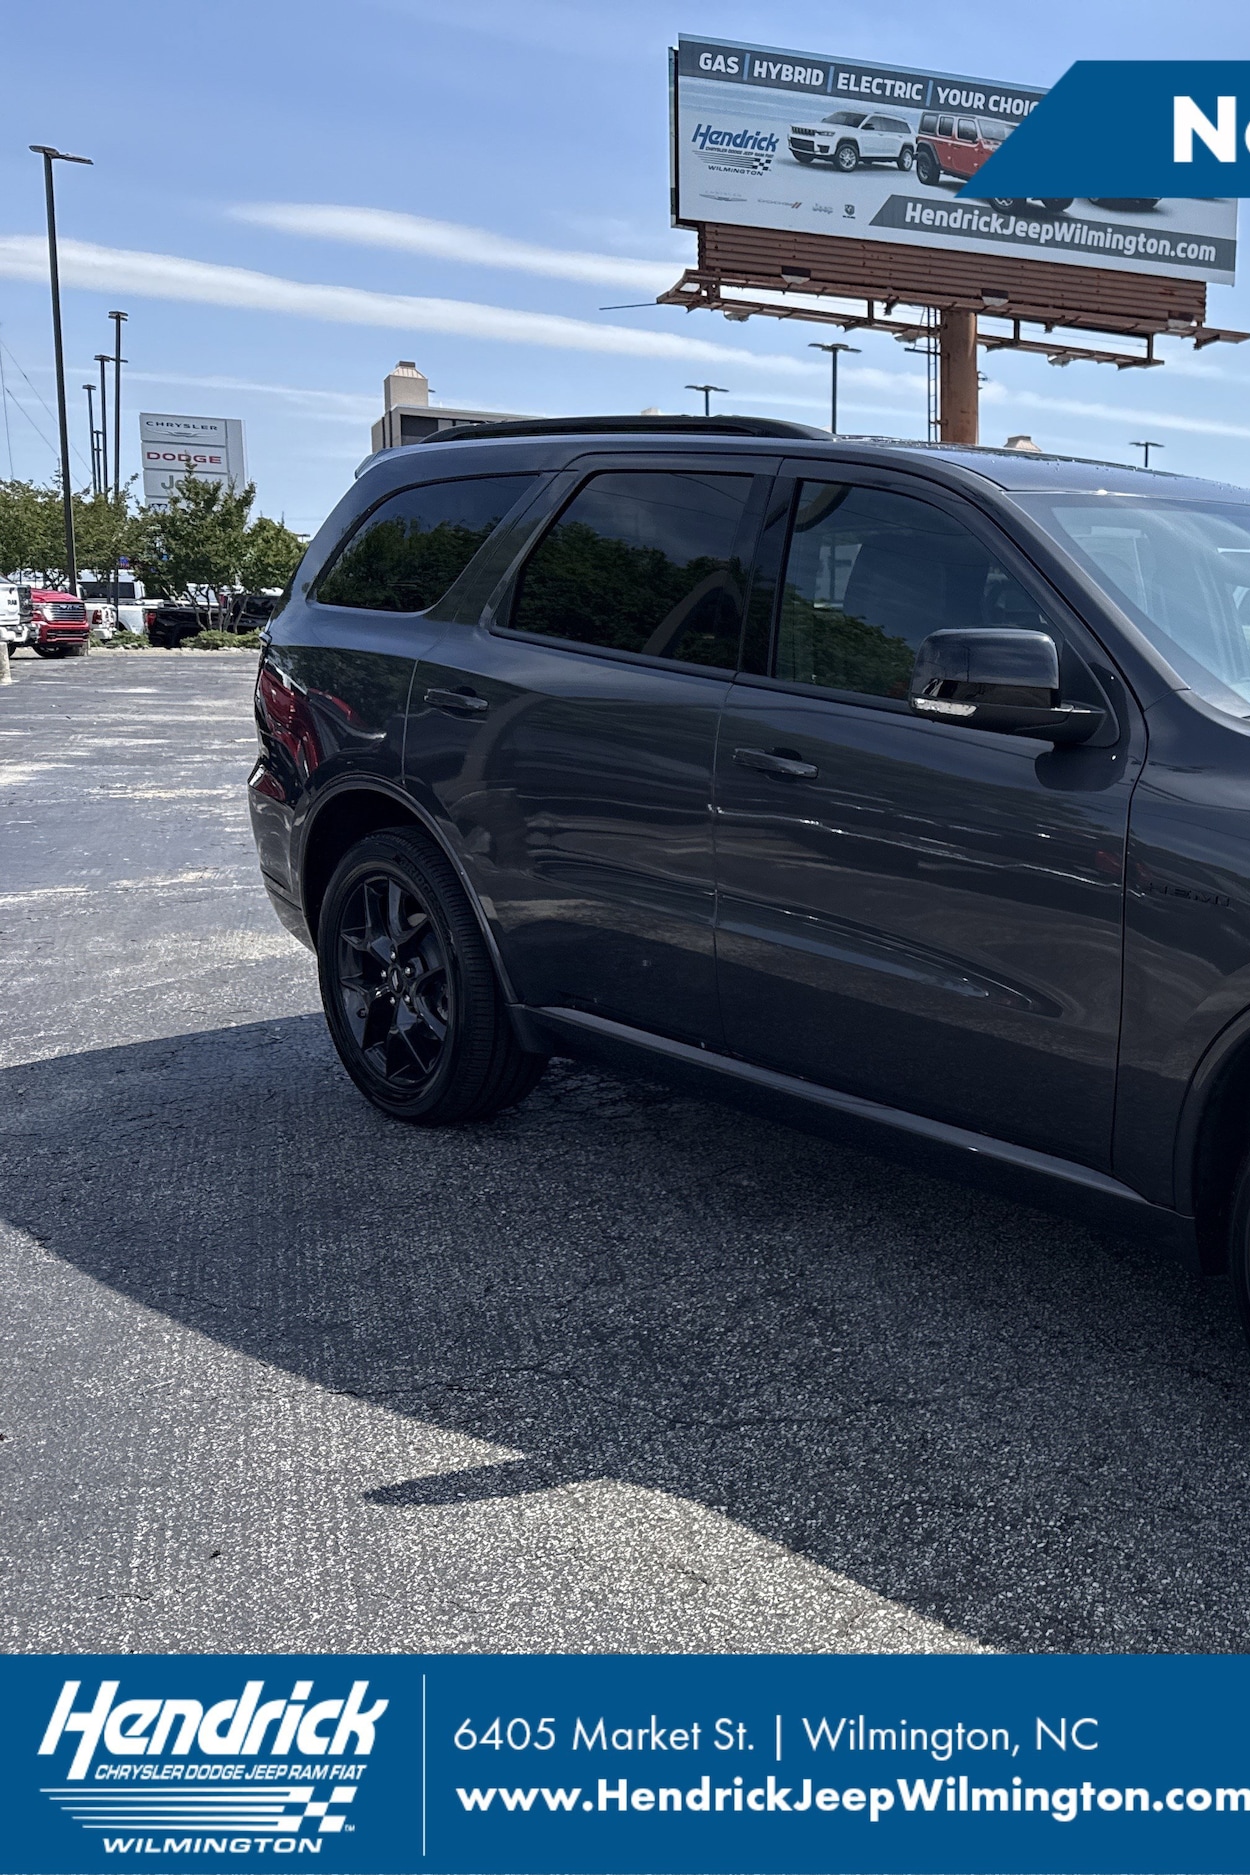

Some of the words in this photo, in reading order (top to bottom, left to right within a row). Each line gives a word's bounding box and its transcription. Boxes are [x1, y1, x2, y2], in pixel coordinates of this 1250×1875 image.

[699, 52, 740, 75] GAS
[753, 60, 825, 86] HYBRID
[836, 72, 924, 100] ELECTRIC
[937, 86, 984, 110] YOUR
[692, 124, 779, 152] Hendrick
[708, 165, 764, 176] WILMINGTON
[905, 202, 1216, 262] HendrickJeepWilmington.com
[145, 420, 218, 431] CHRYSLER
[146, 451, 222, 464] DODGE
